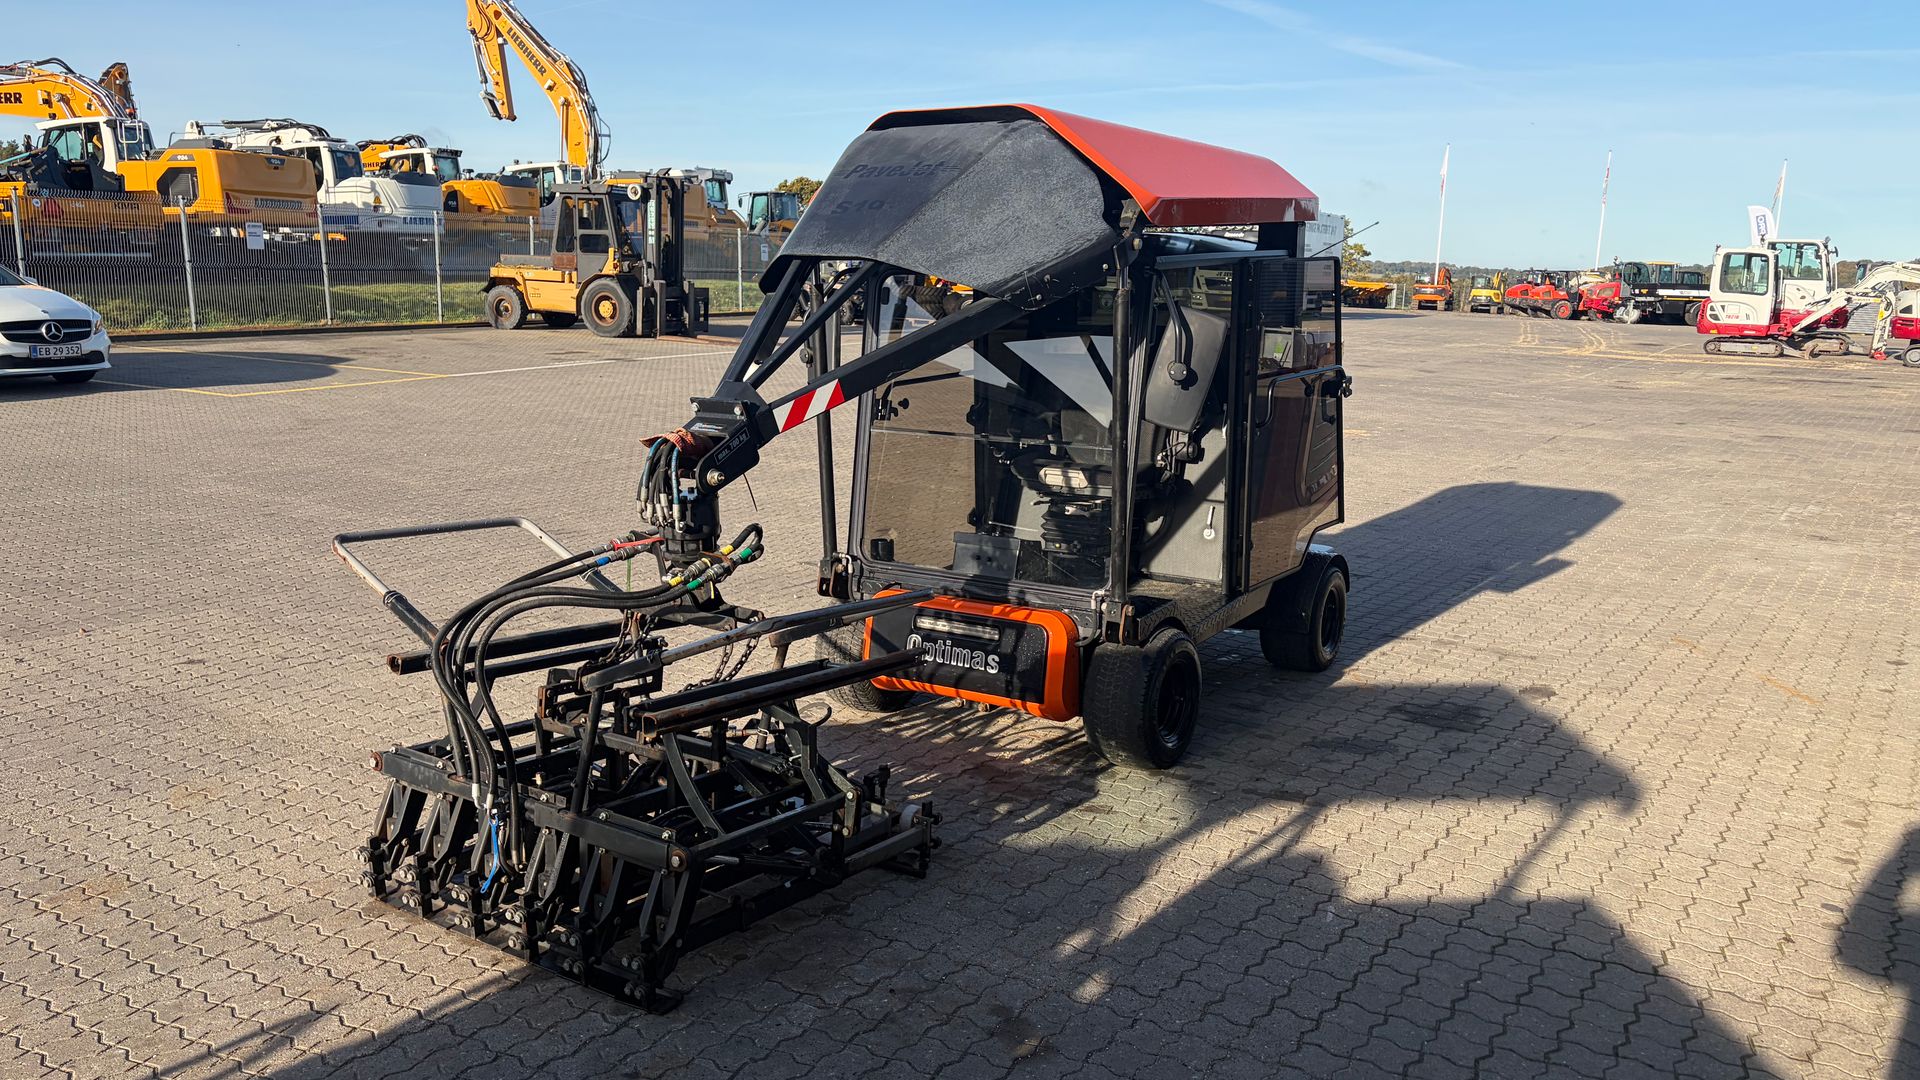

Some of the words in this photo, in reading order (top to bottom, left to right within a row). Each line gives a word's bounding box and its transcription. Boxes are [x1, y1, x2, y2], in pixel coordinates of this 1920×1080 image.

[507, 27, 547, 77] LIEBHERR
[38, 347, 51, 356] EB
[53, 346, 64, 356] 29
[65, 346, 80, 355] 352
[739, 432, 748, 442] kg
[906, 634, 1000, 674] Optimas
